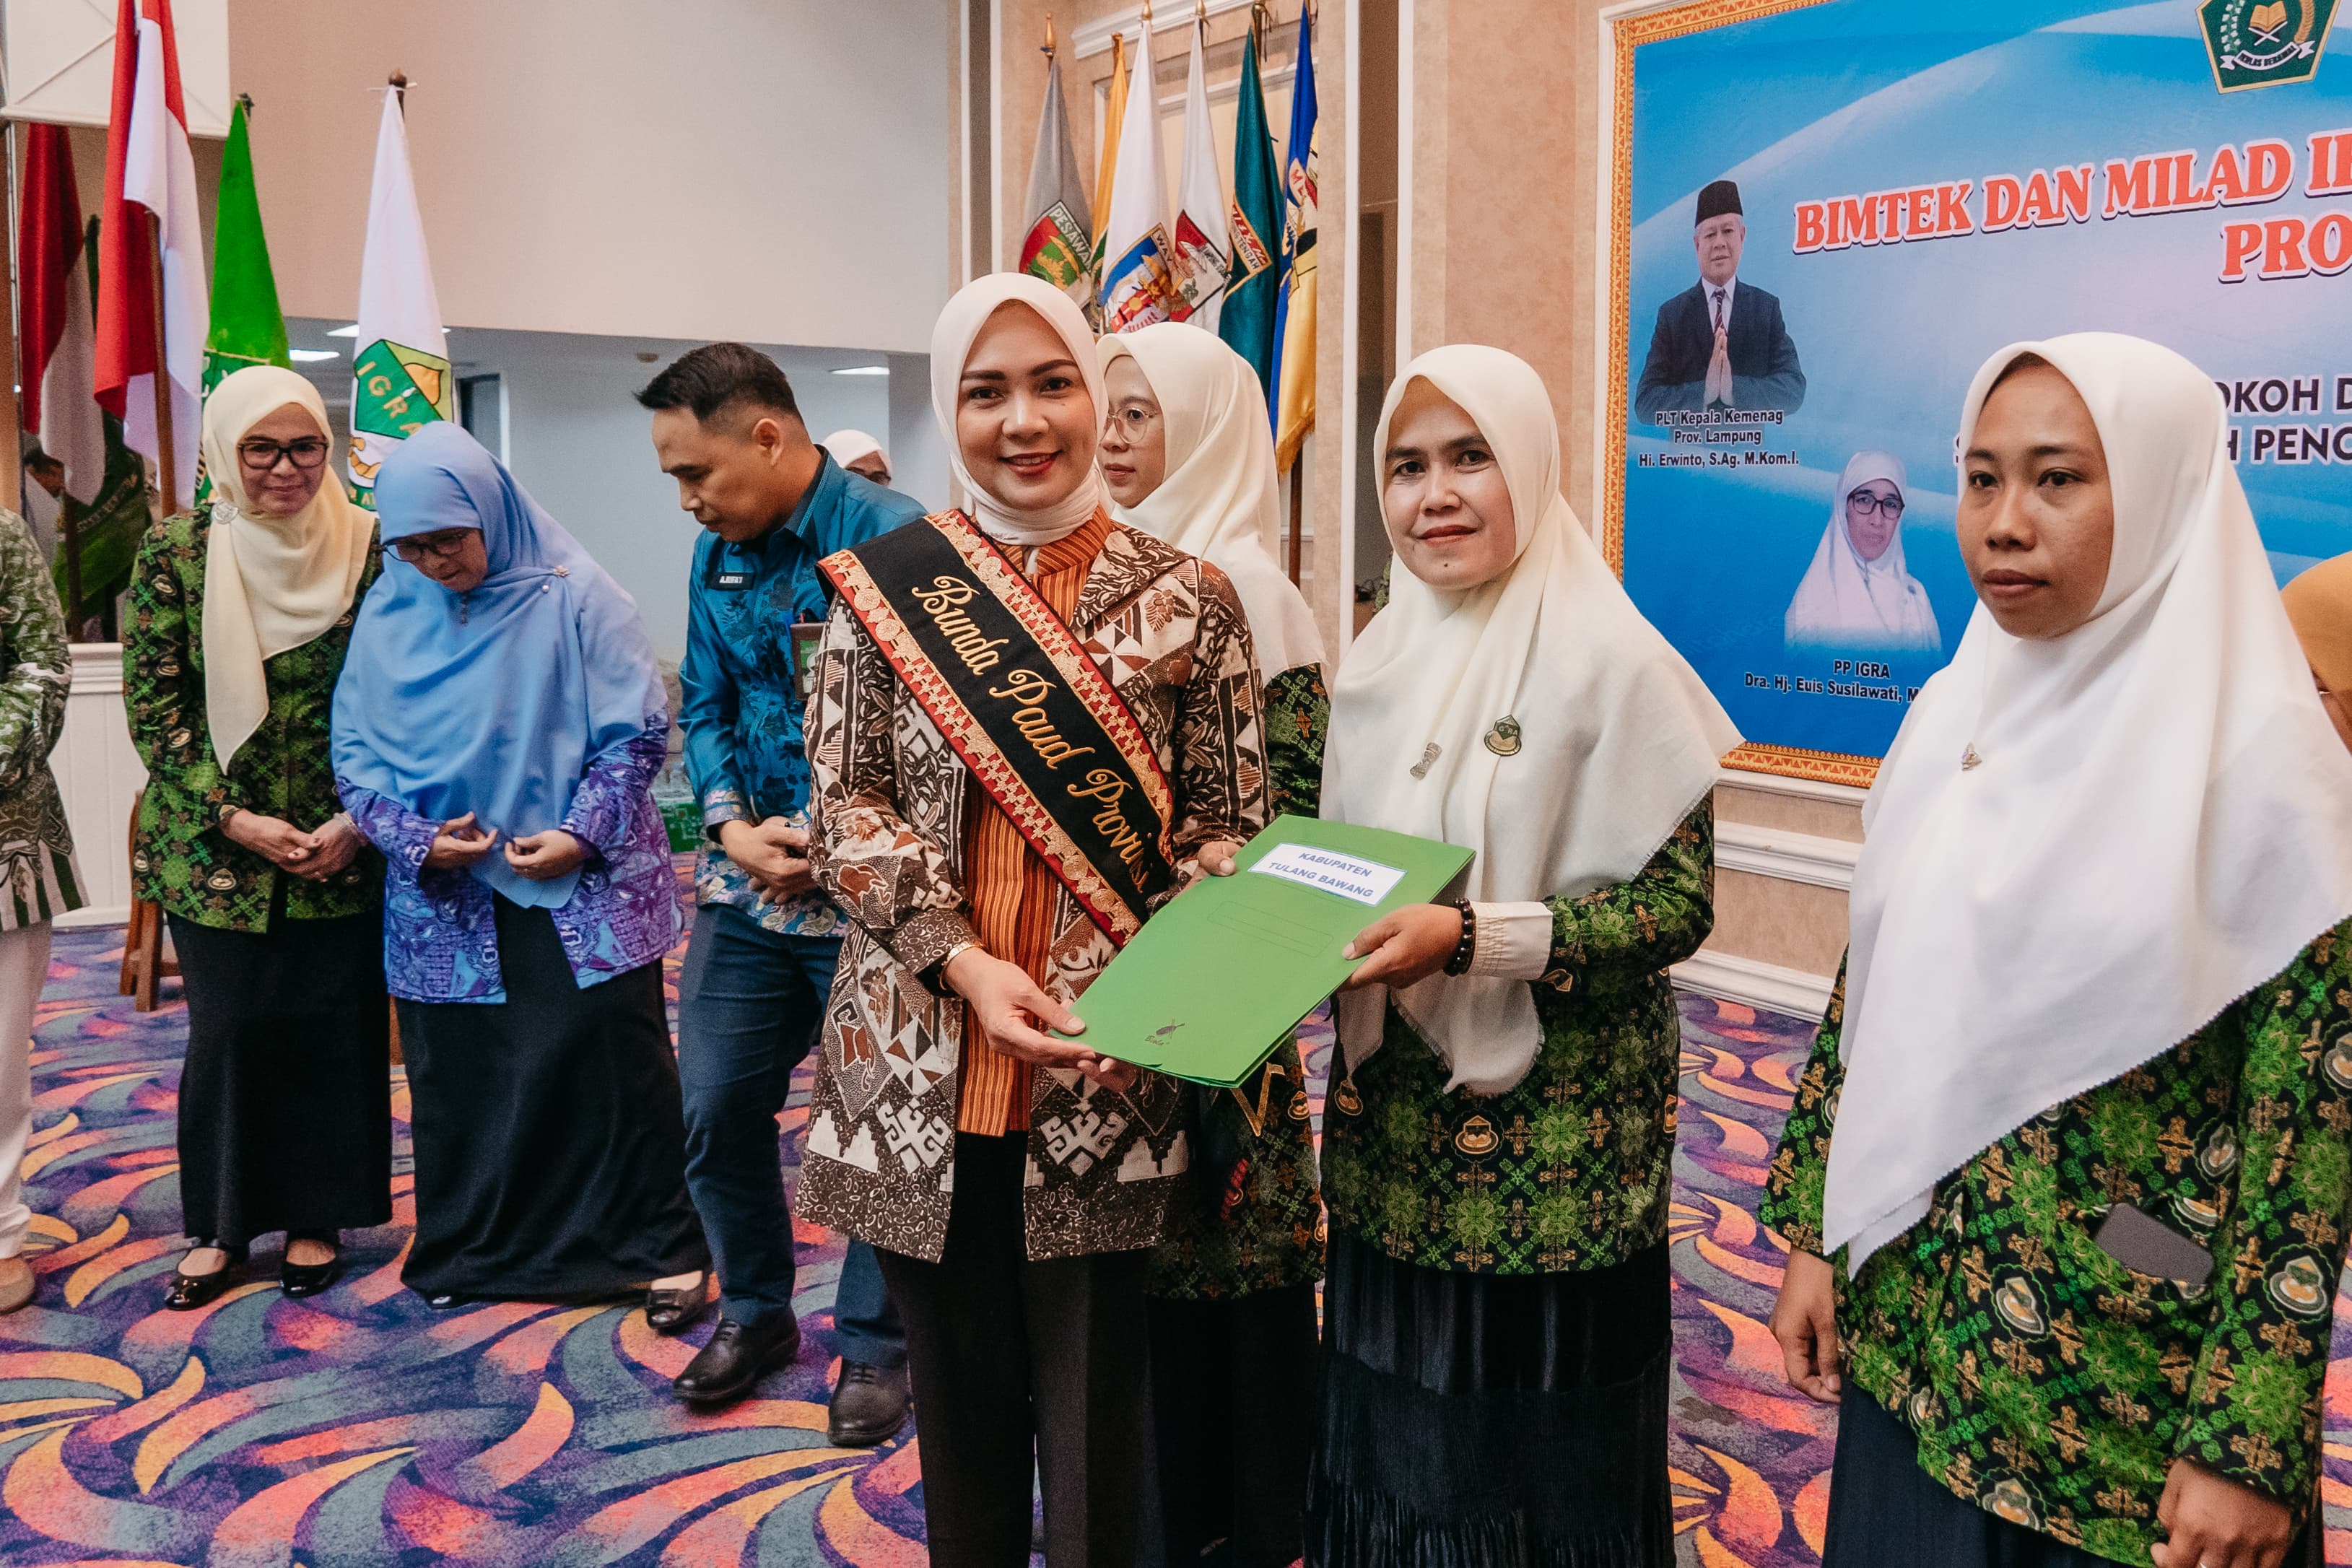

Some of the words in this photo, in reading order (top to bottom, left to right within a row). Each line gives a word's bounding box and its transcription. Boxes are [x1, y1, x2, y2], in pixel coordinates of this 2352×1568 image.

[1795, 181, 1973, 251] BIMTEK
[1983, 167, 2092, 227] DAN
[2104, 143, 2292, 214] MILAD
[2221, 213, 2352, 276] PRO
[1655, 411, 1677, 425] PLT
[1681, 409, 1720, 428] Kepala
[1725, 409, 1783, 426] Kemenag
[1674, 430, 1702, 443] Prov.
[1706, 429, 1761, 445] Lampung
[1639, 453, 1655, 467] Hi.
[1659, 452, 1706, 469] Erwinto,
[1709, 452, 1740, 469] S.Ag.
[912, 575, 1009, 675] Bunda
[989, 669, 1094, 770] Paud
[1834, 660, 1851, 675] PP
[1855, 661, 1891, 679] IGRA
[1745, 673, 1769, 688] Dra.
[1774, 675, 1792, 693] Hj.
[1796, 677, 1823, 694] Euis
[1827, 680, 1902, 704] Susilawati,
[1298, 852, 1372, 877] KABUPATEN
[1268, 862, 1317, 879] TULANG
[1317, 875, 1374, 897] BAWANG
